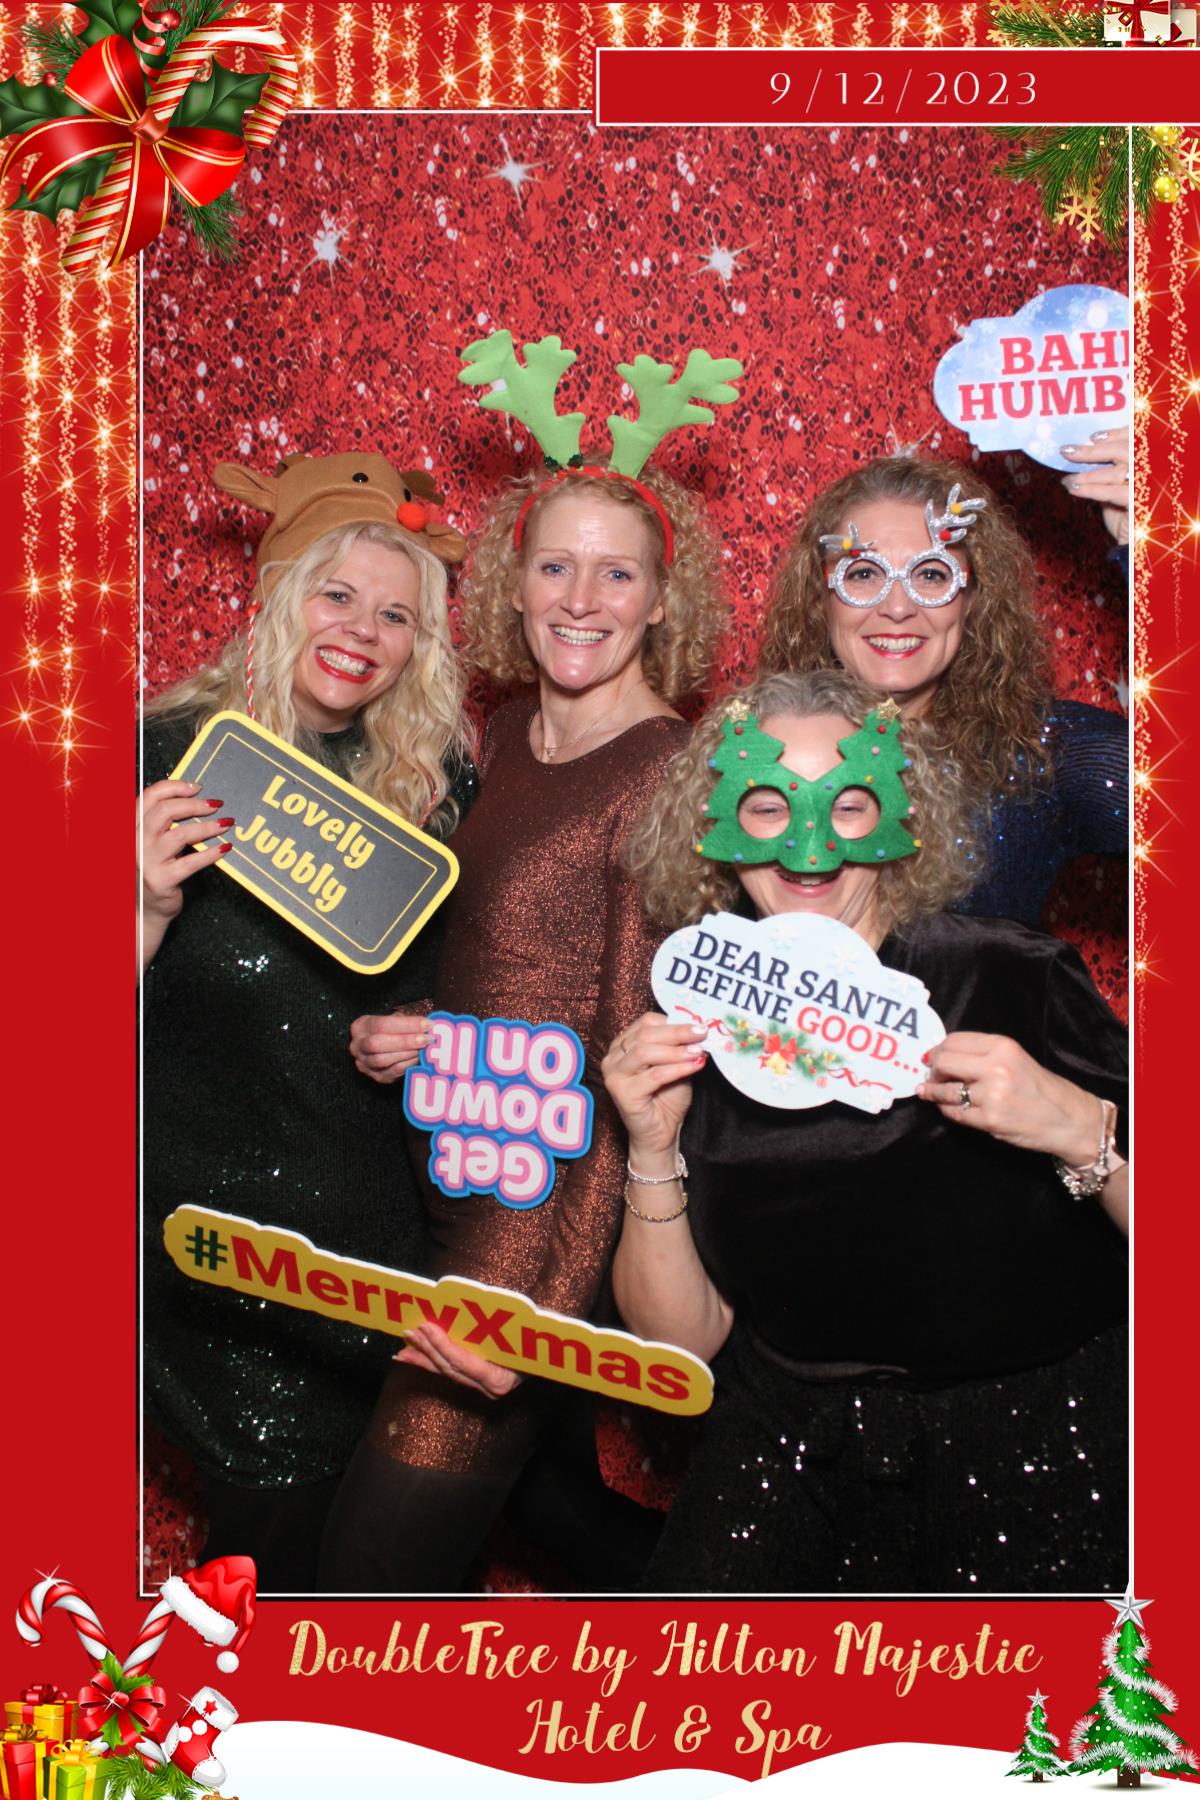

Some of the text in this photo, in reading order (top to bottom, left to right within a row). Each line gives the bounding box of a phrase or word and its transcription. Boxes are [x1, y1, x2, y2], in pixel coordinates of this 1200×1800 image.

[957, 374, 1129, 422] HUMB
[234, 814, 347, 913] Jubbly
[261, 774, 376, 869] Lovely
[665, 957, 919, 1075] DEFINE GOOD...
[690, 931, 920, 1039] DEAR SANTA
[425, 1019, 578, 1091] On It
[409, 1073, 587, 1150] Down
[433, 1132, 549, 1201] Get
[185, 1225, 692, 1402] #MerryXmas
